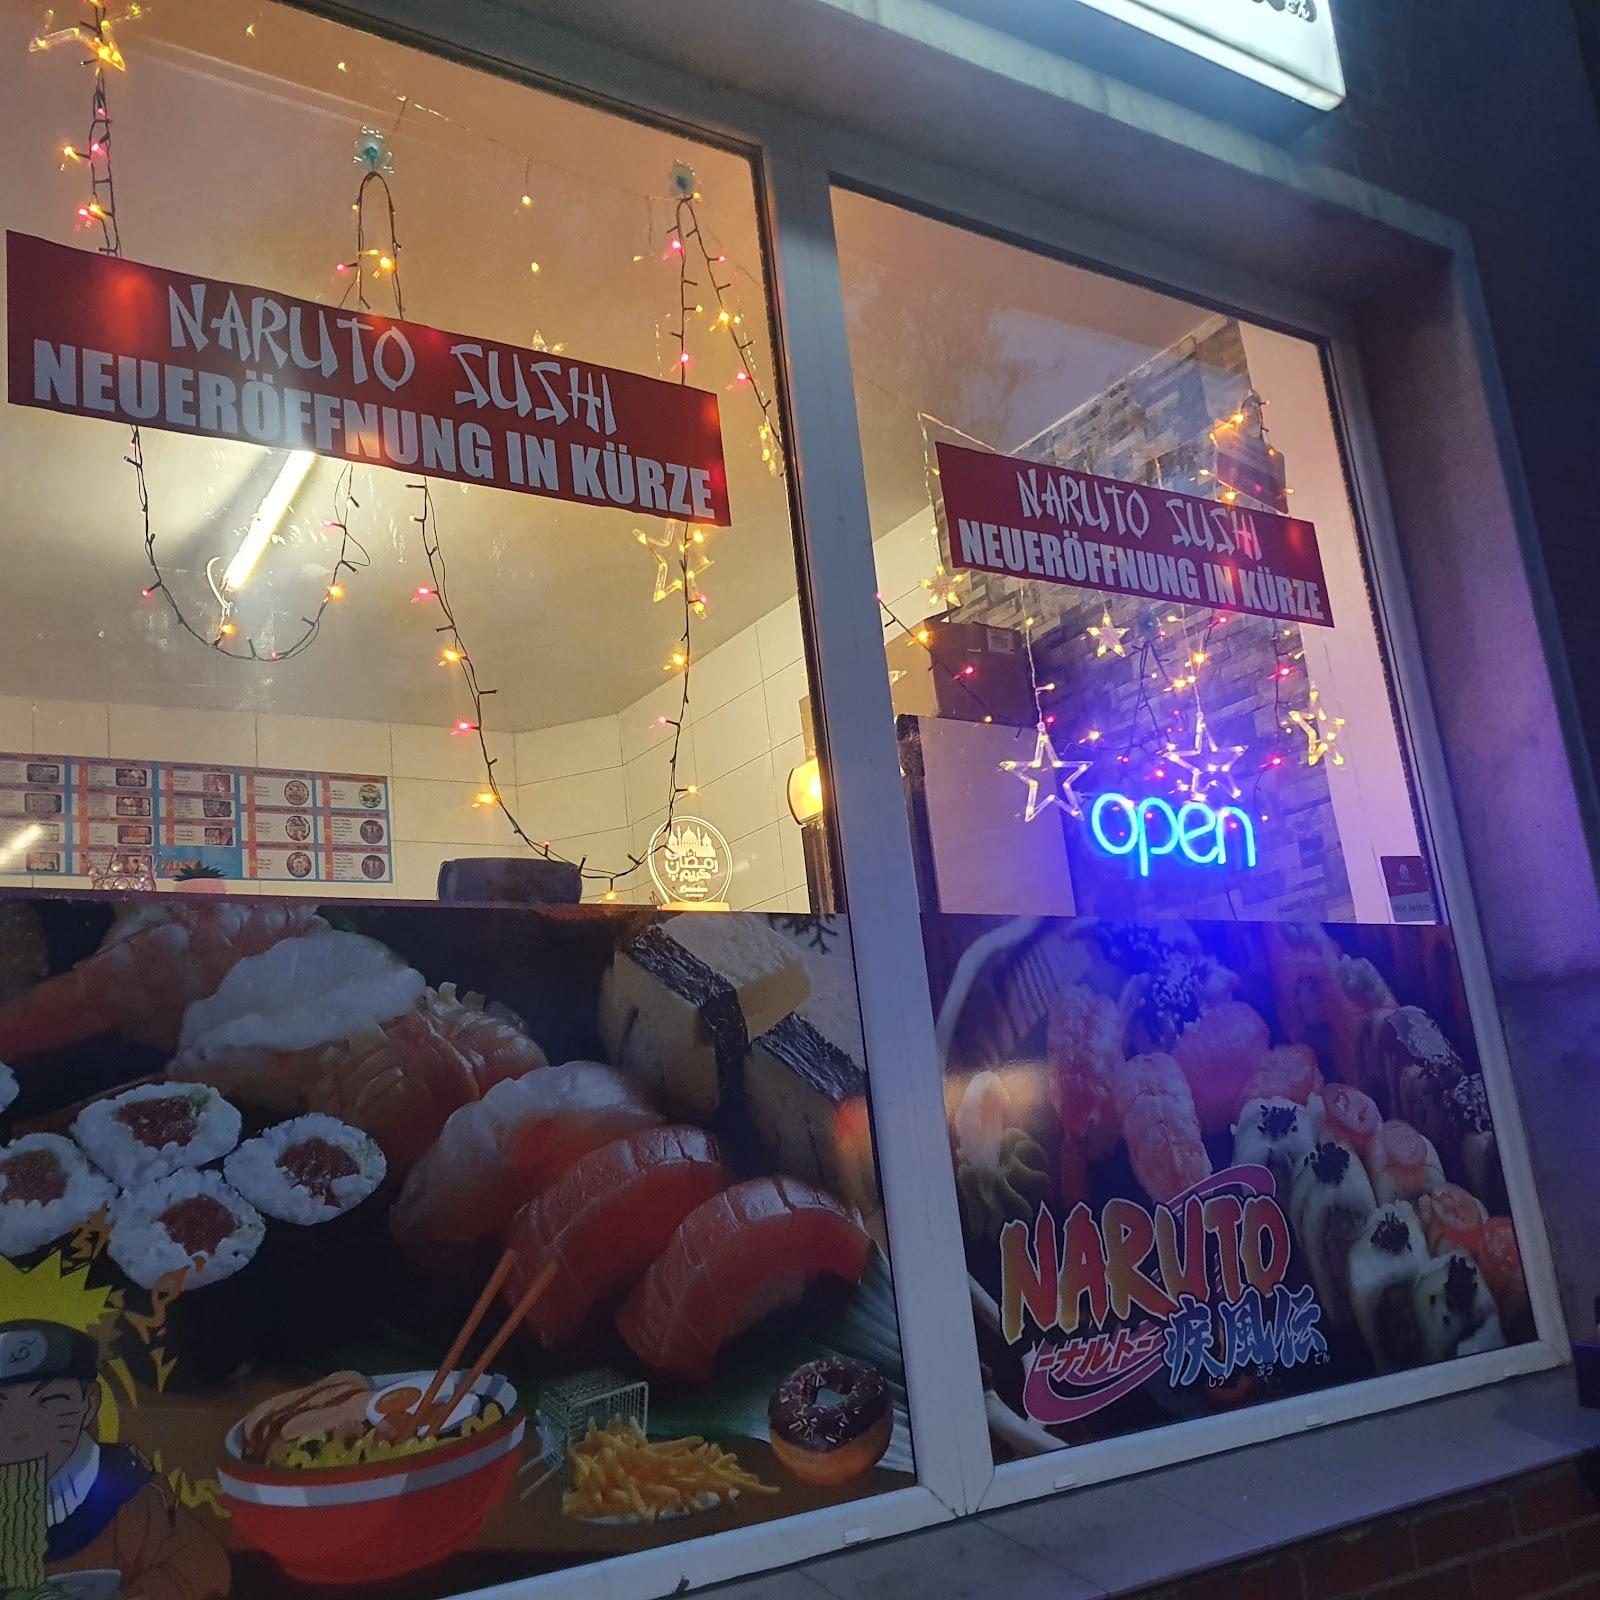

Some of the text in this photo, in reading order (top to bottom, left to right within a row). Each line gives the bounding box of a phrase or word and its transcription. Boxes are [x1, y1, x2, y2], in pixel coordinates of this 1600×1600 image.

[168, 283, 619, 436] NARUTO SUSHI
[33, 339, 715, 520] NEUERÖFFNUNG IN KÜRZE
[1017, 468, 1263, 562] NARUTO SUSHI
[958, 518, 1325, 621] NEUERÖFFNUNG IN KÜRZE
[1091, 792, 1257, 877] open
[1000, 1194, 1291, 1345] NARUTO
[1164, 1284, 1328, 1387] 疾風伝
